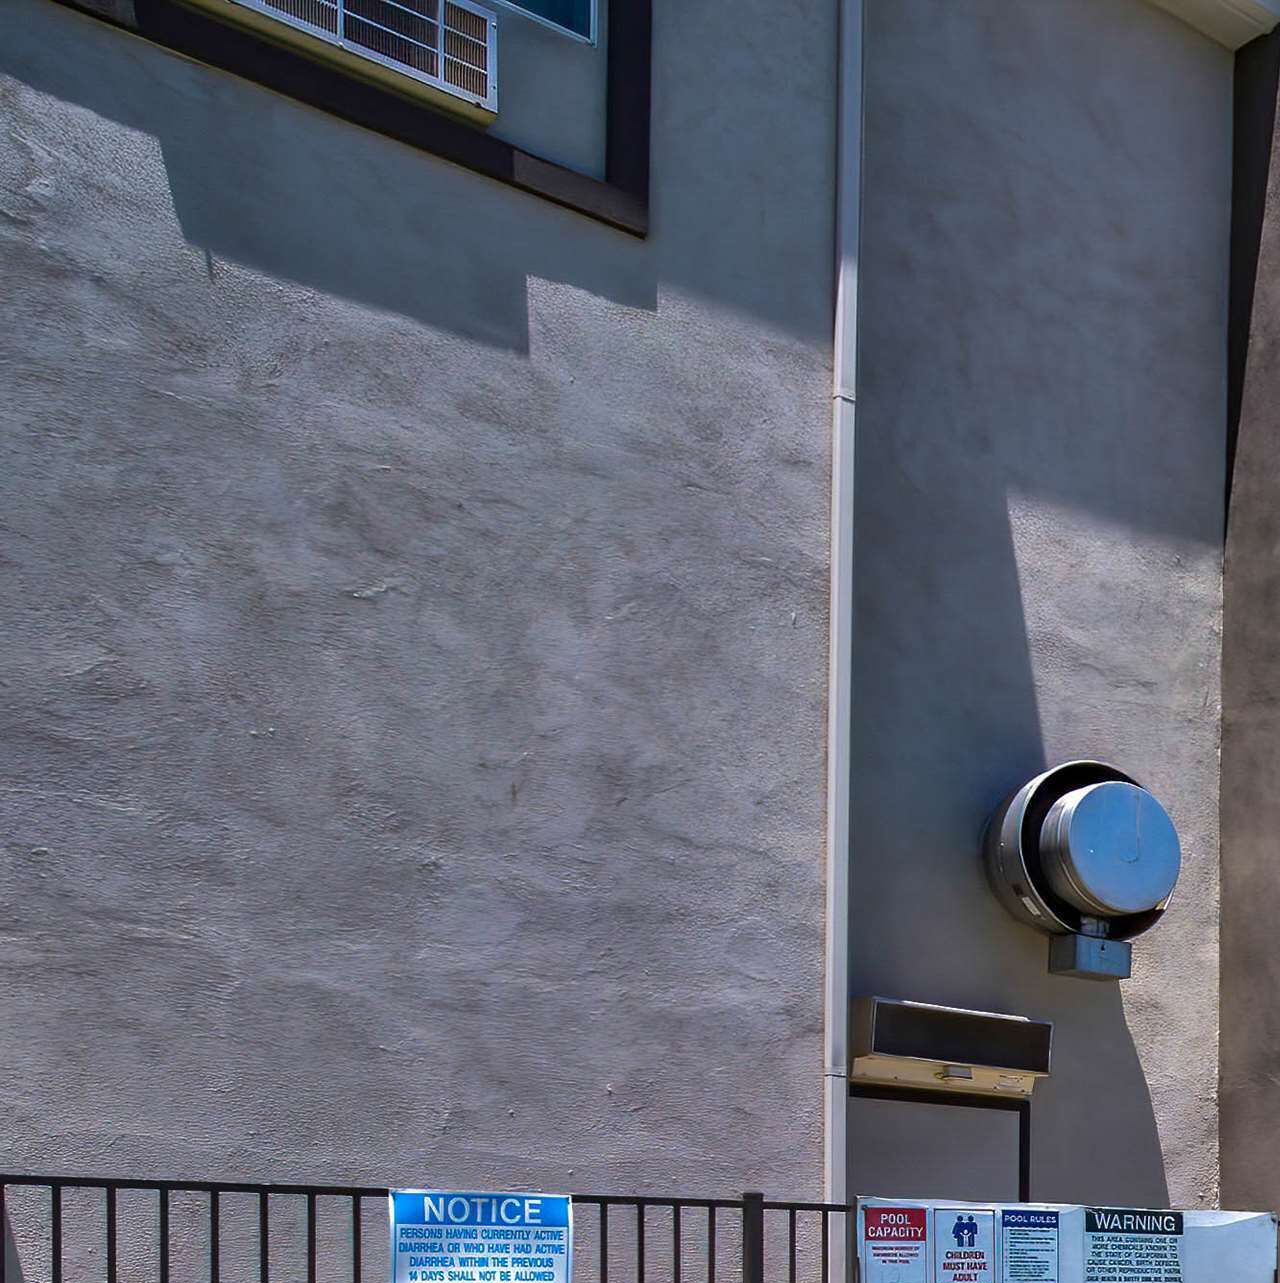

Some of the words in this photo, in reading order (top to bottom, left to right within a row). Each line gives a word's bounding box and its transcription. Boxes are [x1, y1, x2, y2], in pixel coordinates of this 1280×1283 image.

[423, 1197, 542, 1224] NOTICE
[880, 1214, 911, 1225] POOL
[1005, 1215, 1027, 1223] POOL
[1095, 1214, 1176, 1232] WARNING
[400, 1229, 443, 1239] PERSONS
[446, 1229, 478, 1239] HAVING
[481, 1230, 530, 1240] CURRENTLY
[535, 1231, 563, 1241] ACTIVE
[868, 1227, 923, 1237] CAPACITY
[399, 1243, 444, 1253] DIARRHEA
[448, 1243, 461, 1253] OR
[464, 1244, 485, 1254] WHO
[488, 1244, 510, 1254] HAVE
[514, 1245, 531, 1254] HAD
[535, 1245, 565, 1255] ACTIVE
[945, 1251, 985, 1259] CHILDREN
[410, 1257, 455, 1267] DIARRHEA
[459, 1257, 489, 1267] WITHIN
[492, 1258, 508, 1267] THE
[512, 1258, 554, 1268] PREVIOUS
[943, 1262, 965, 1270] MUST
[967, 1262, 988, 1271] HAVE
[409, 1271, 418, 1281] 14
[421, 1271, 444, 1281] DAYS
[448, 1271, 476, 1281] SHALL
[479, 1271, 497, 1281] NOT
[500, 1272, 511, 1281] BE
[515, 1271, 554, 1281] ALLOWED
[953, 1273, 979, 1281] ADULT
